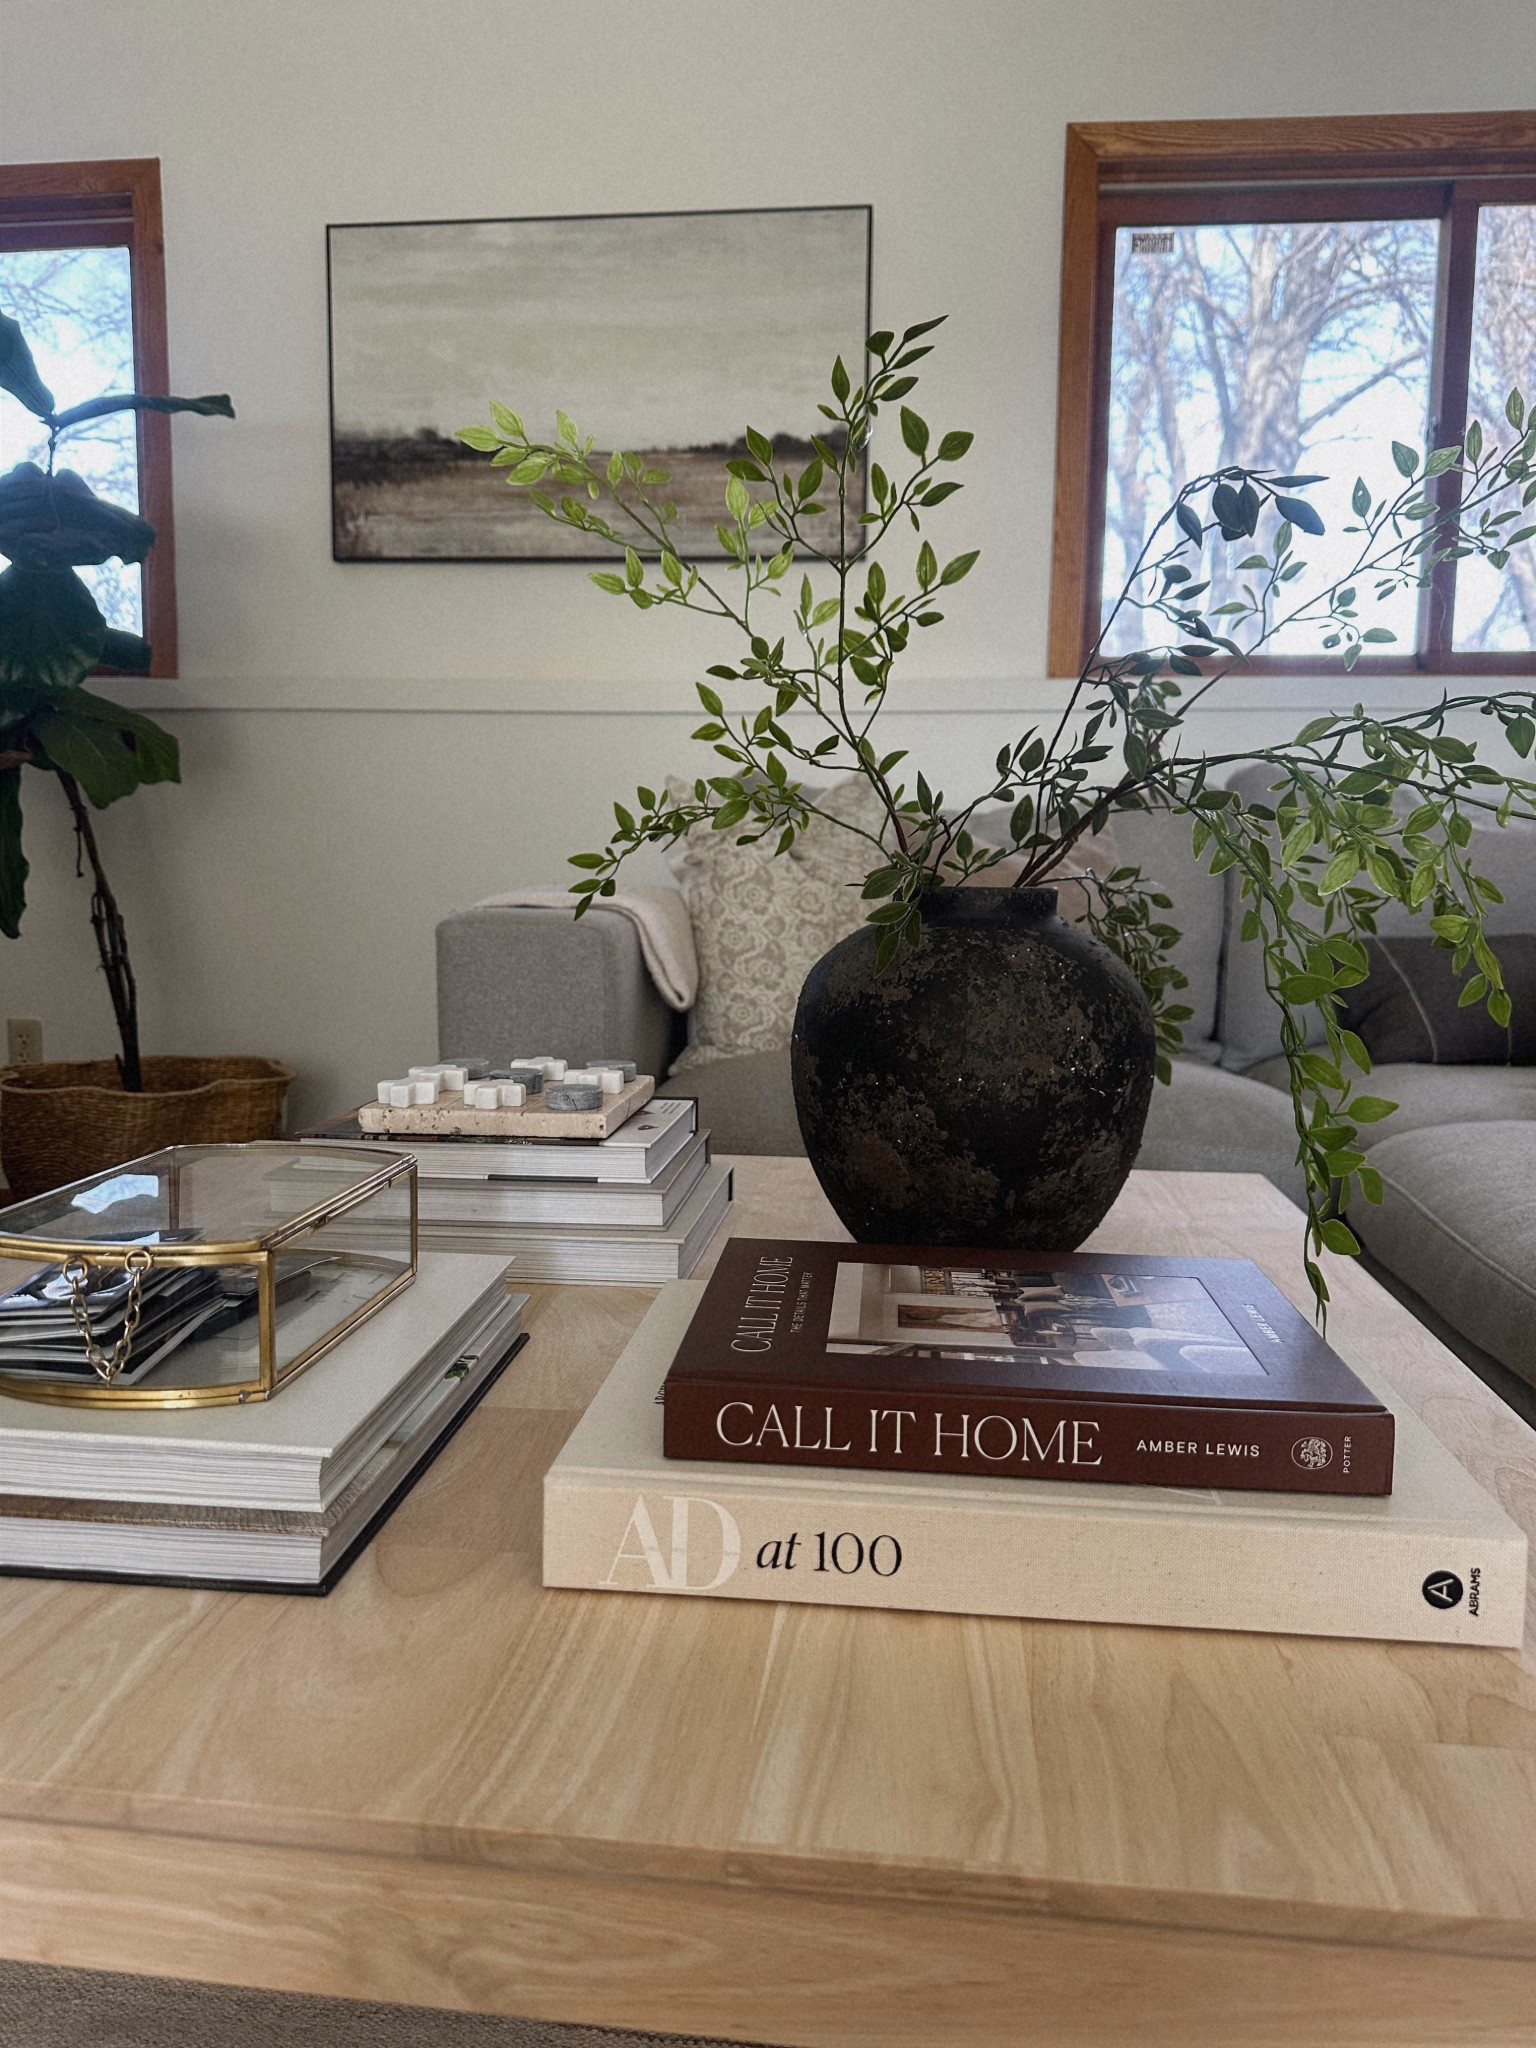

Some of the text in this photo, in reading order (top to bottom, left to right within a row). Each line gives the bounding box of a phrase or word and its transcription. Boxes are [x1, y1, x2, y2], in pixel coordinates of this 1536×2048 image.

[731, 1256, 793, 1352] CALL IT HOME
[790, 1271, 813, 1333] THE DETAILS THAT MATTER
[716, 1402, 1103, 1466] CALL IT HOME
[1136, 1438, 1261, 1457] AMBER LEWIS
[1342, 1435, 1352, 1473] POTTER
[597, 1494, 903, 1590] AD at 100
[1468, 1566, 1481, 1617] ABRAMS
